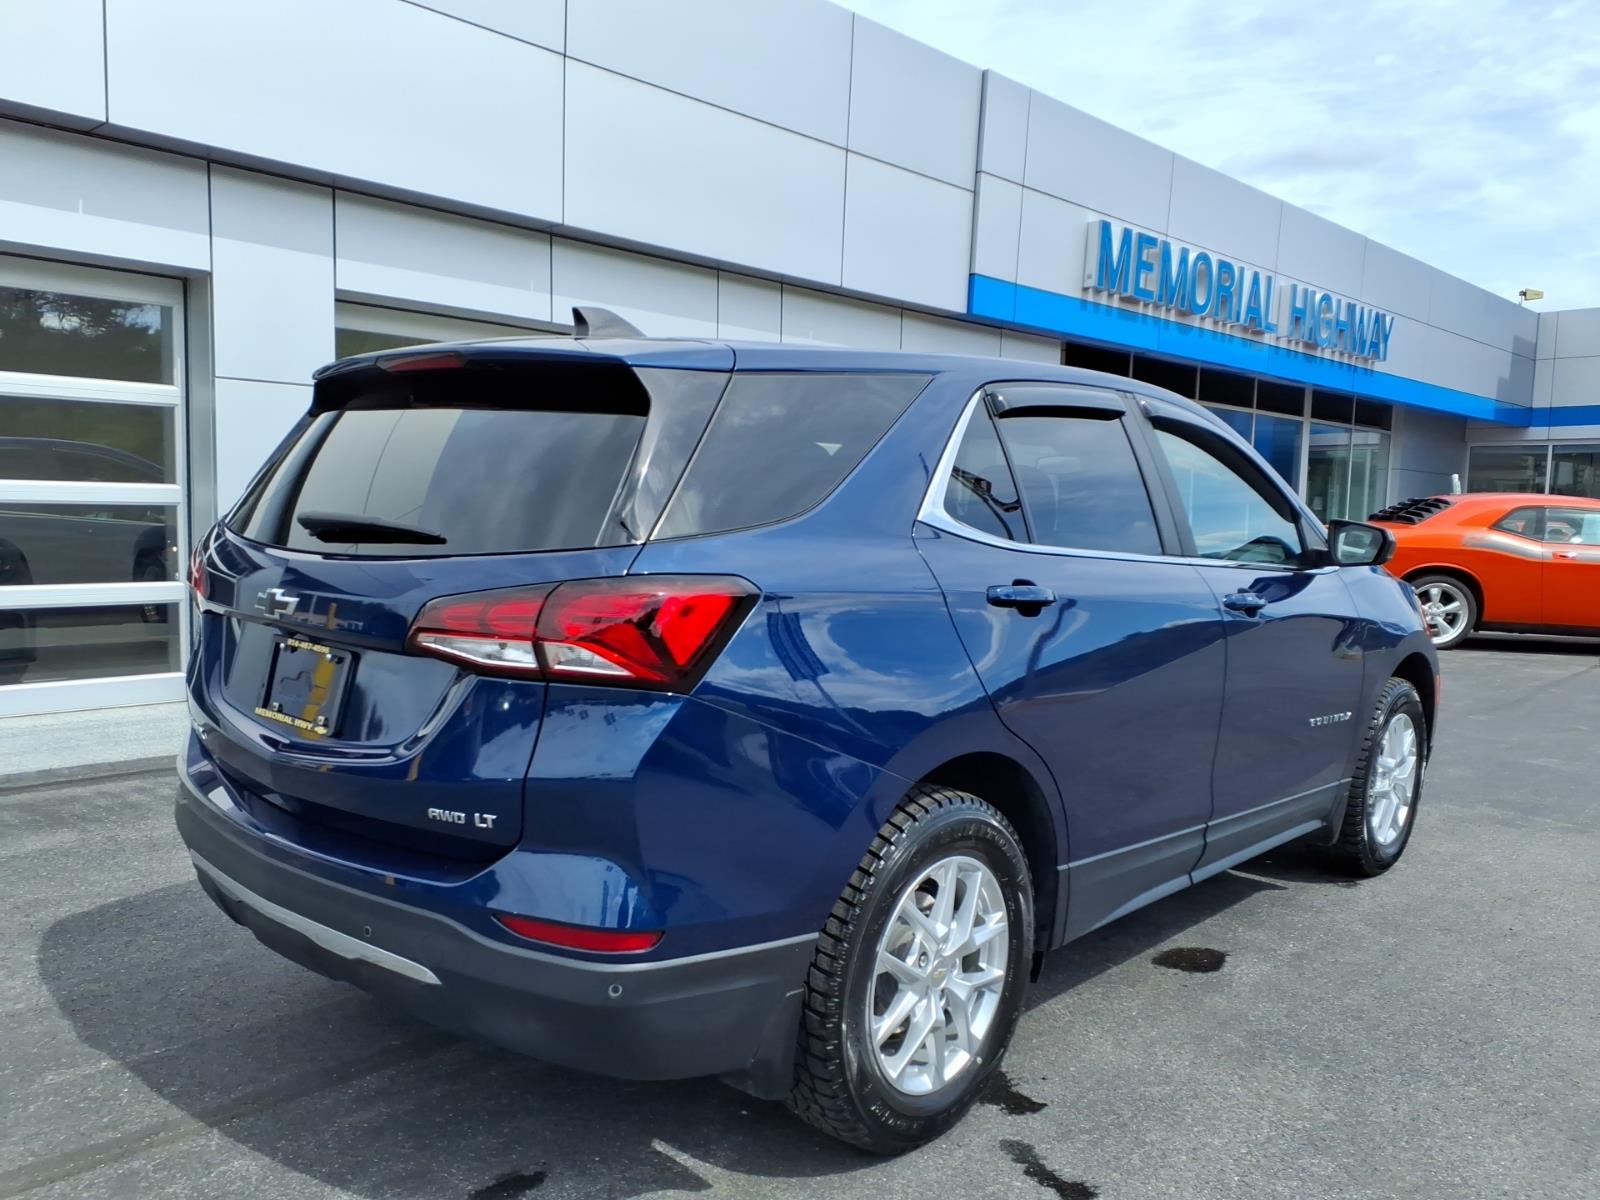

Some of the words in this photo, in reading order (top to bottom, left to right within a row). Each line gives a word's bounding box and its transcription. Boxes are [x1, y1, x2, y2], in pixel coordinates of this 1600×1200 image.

[1096, 219, 1278, 334] MEMORIAL
[1287, 283, 1395, 362] HIGHWAY
[255, 706, 294, 725] MEMORIAL
[294, 718, 313, 730] HWY
[427, 807, 466, 824] AWD
[474, 812, 498, 829] LT
